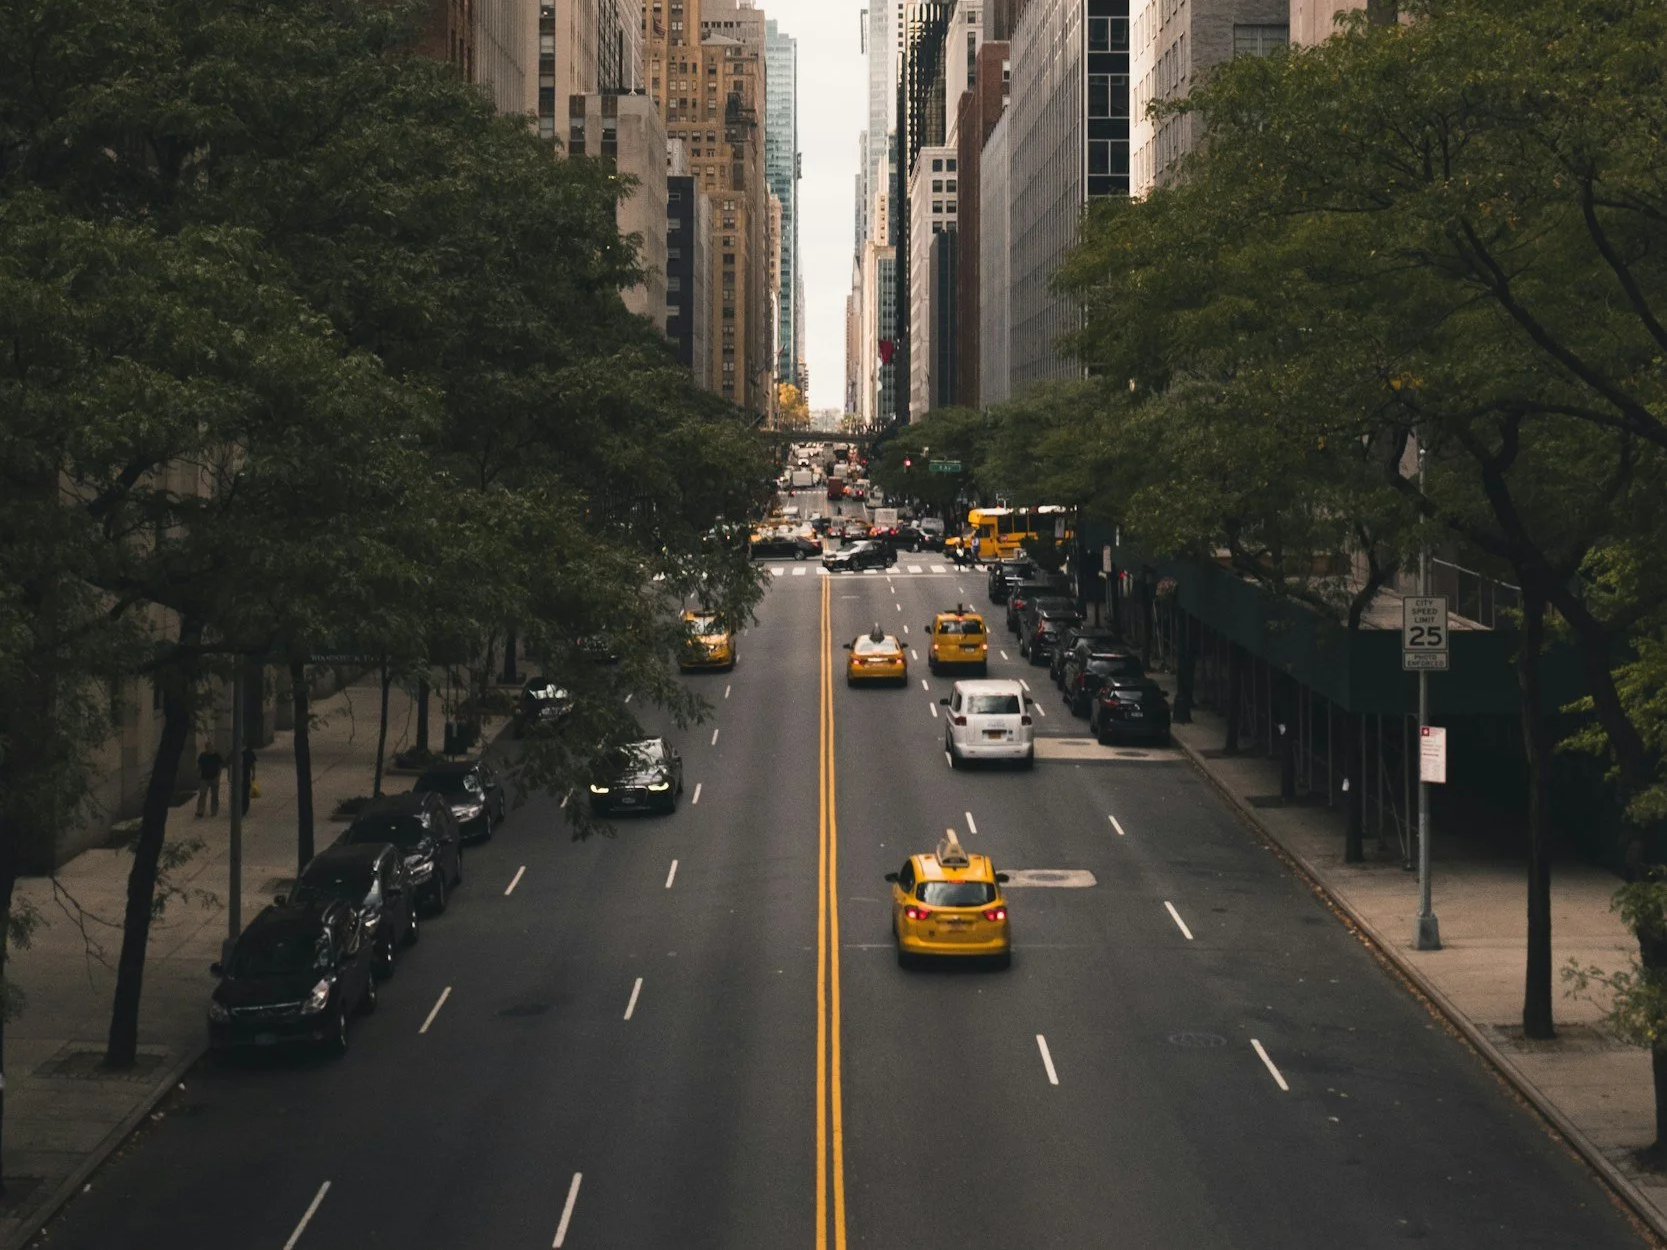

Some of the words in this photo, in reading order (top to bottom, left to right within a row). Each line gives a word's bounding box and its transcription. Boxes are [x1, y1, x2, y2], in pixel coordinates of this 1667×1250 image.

[1415, 599, 1433, 607] CITY
[1411, 608, 1438, 616] SPEED
[1409, 626, 1442, 646] 25
